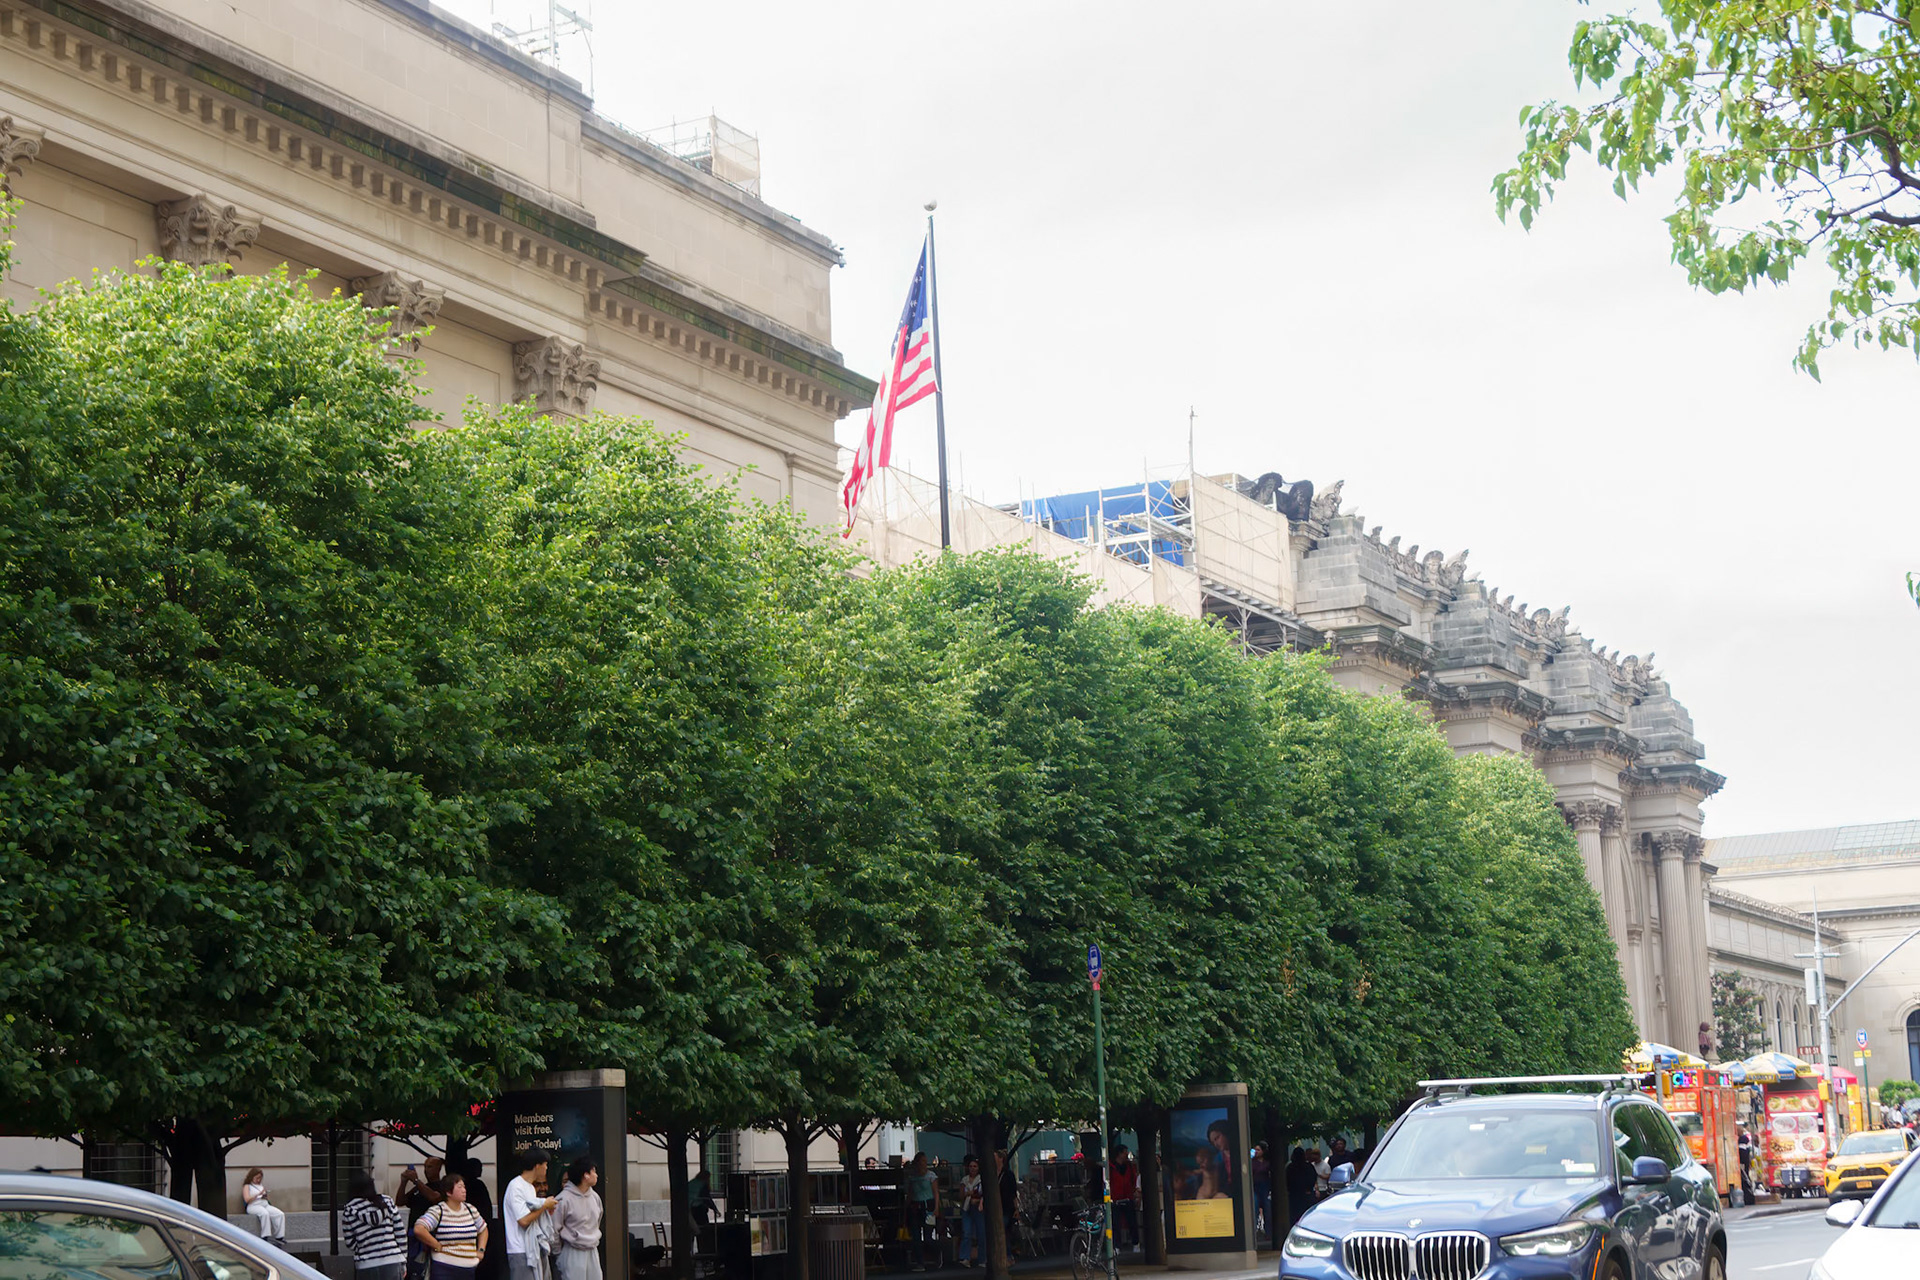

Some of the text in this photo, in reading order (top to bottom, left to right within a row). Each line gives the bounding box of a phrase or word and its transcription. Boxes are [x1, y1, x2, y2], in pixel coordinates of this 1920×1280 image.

[514, 1113, 554, 1124] Members
[514, 1124, 553, 1136] visit free.
[533, 1138, 562, 1151] Today!
